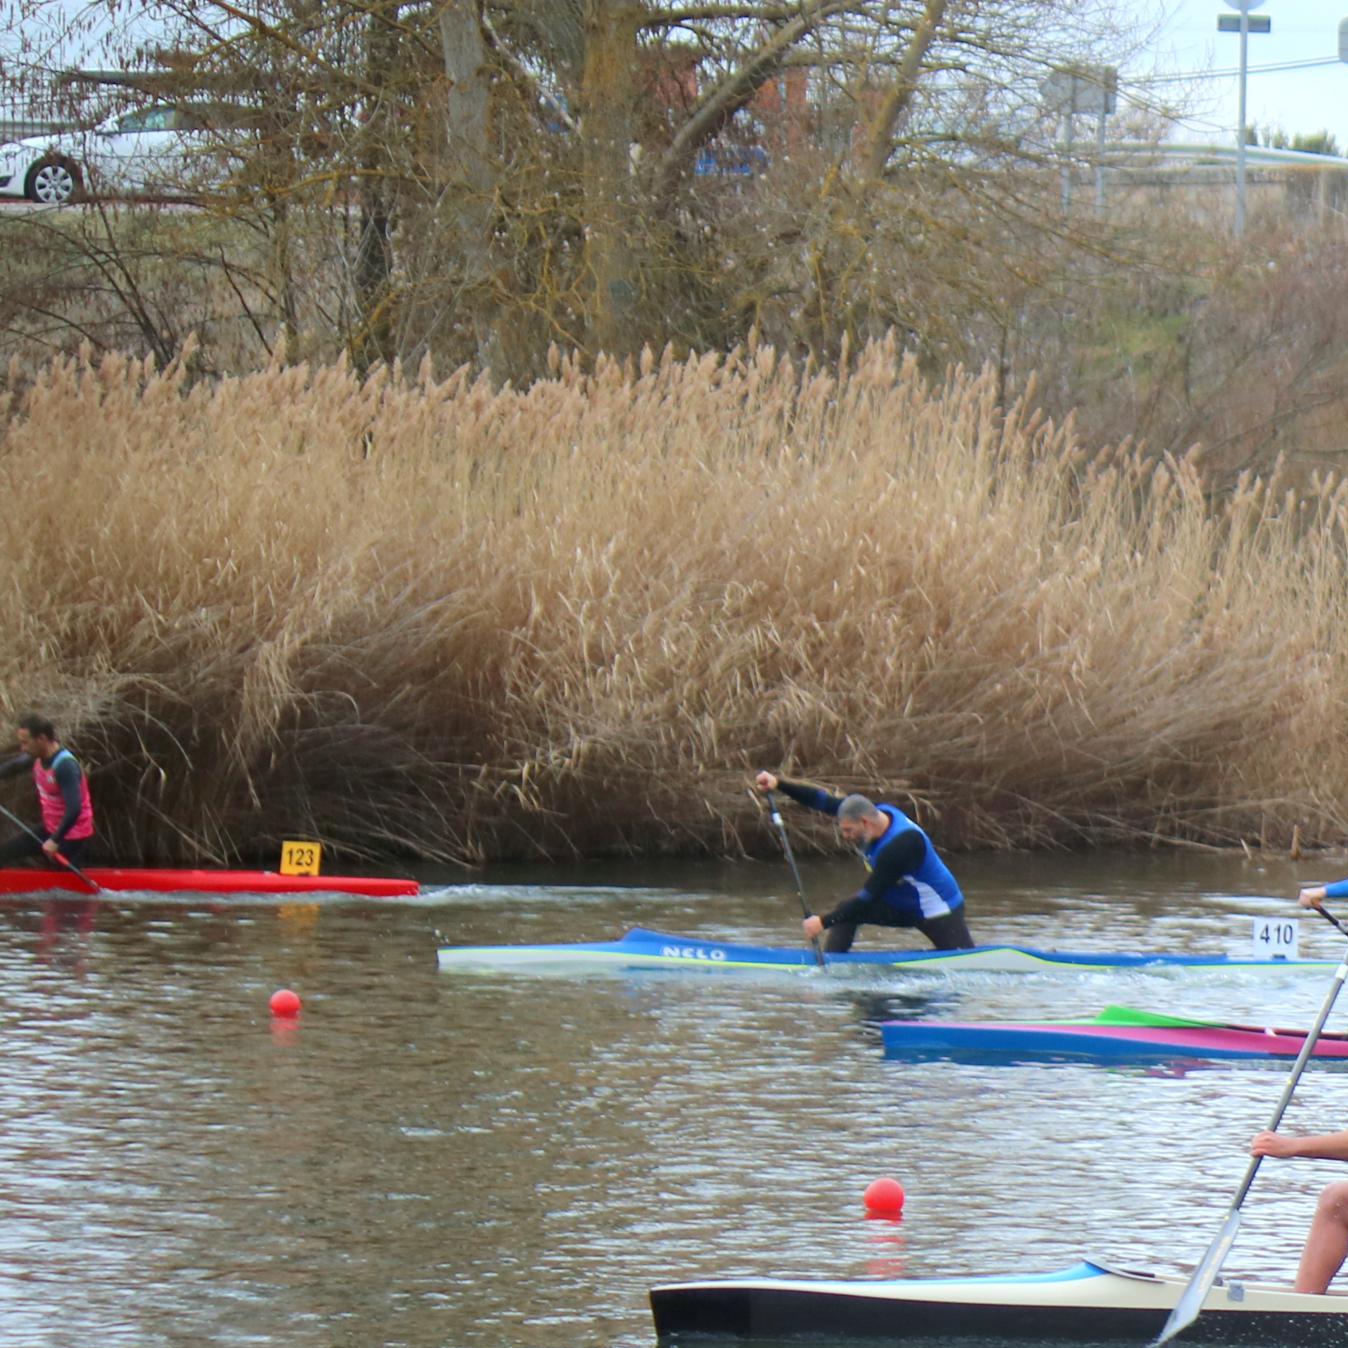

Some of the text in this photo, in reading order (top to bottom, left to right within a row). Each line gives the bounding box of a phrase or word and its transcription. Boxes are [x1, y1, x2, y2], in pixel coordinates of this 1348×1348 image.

[287, 848, 314, 867] 123
[1260, 924, 1294, 945] 410
[662, 946, 726, 961] NELO
